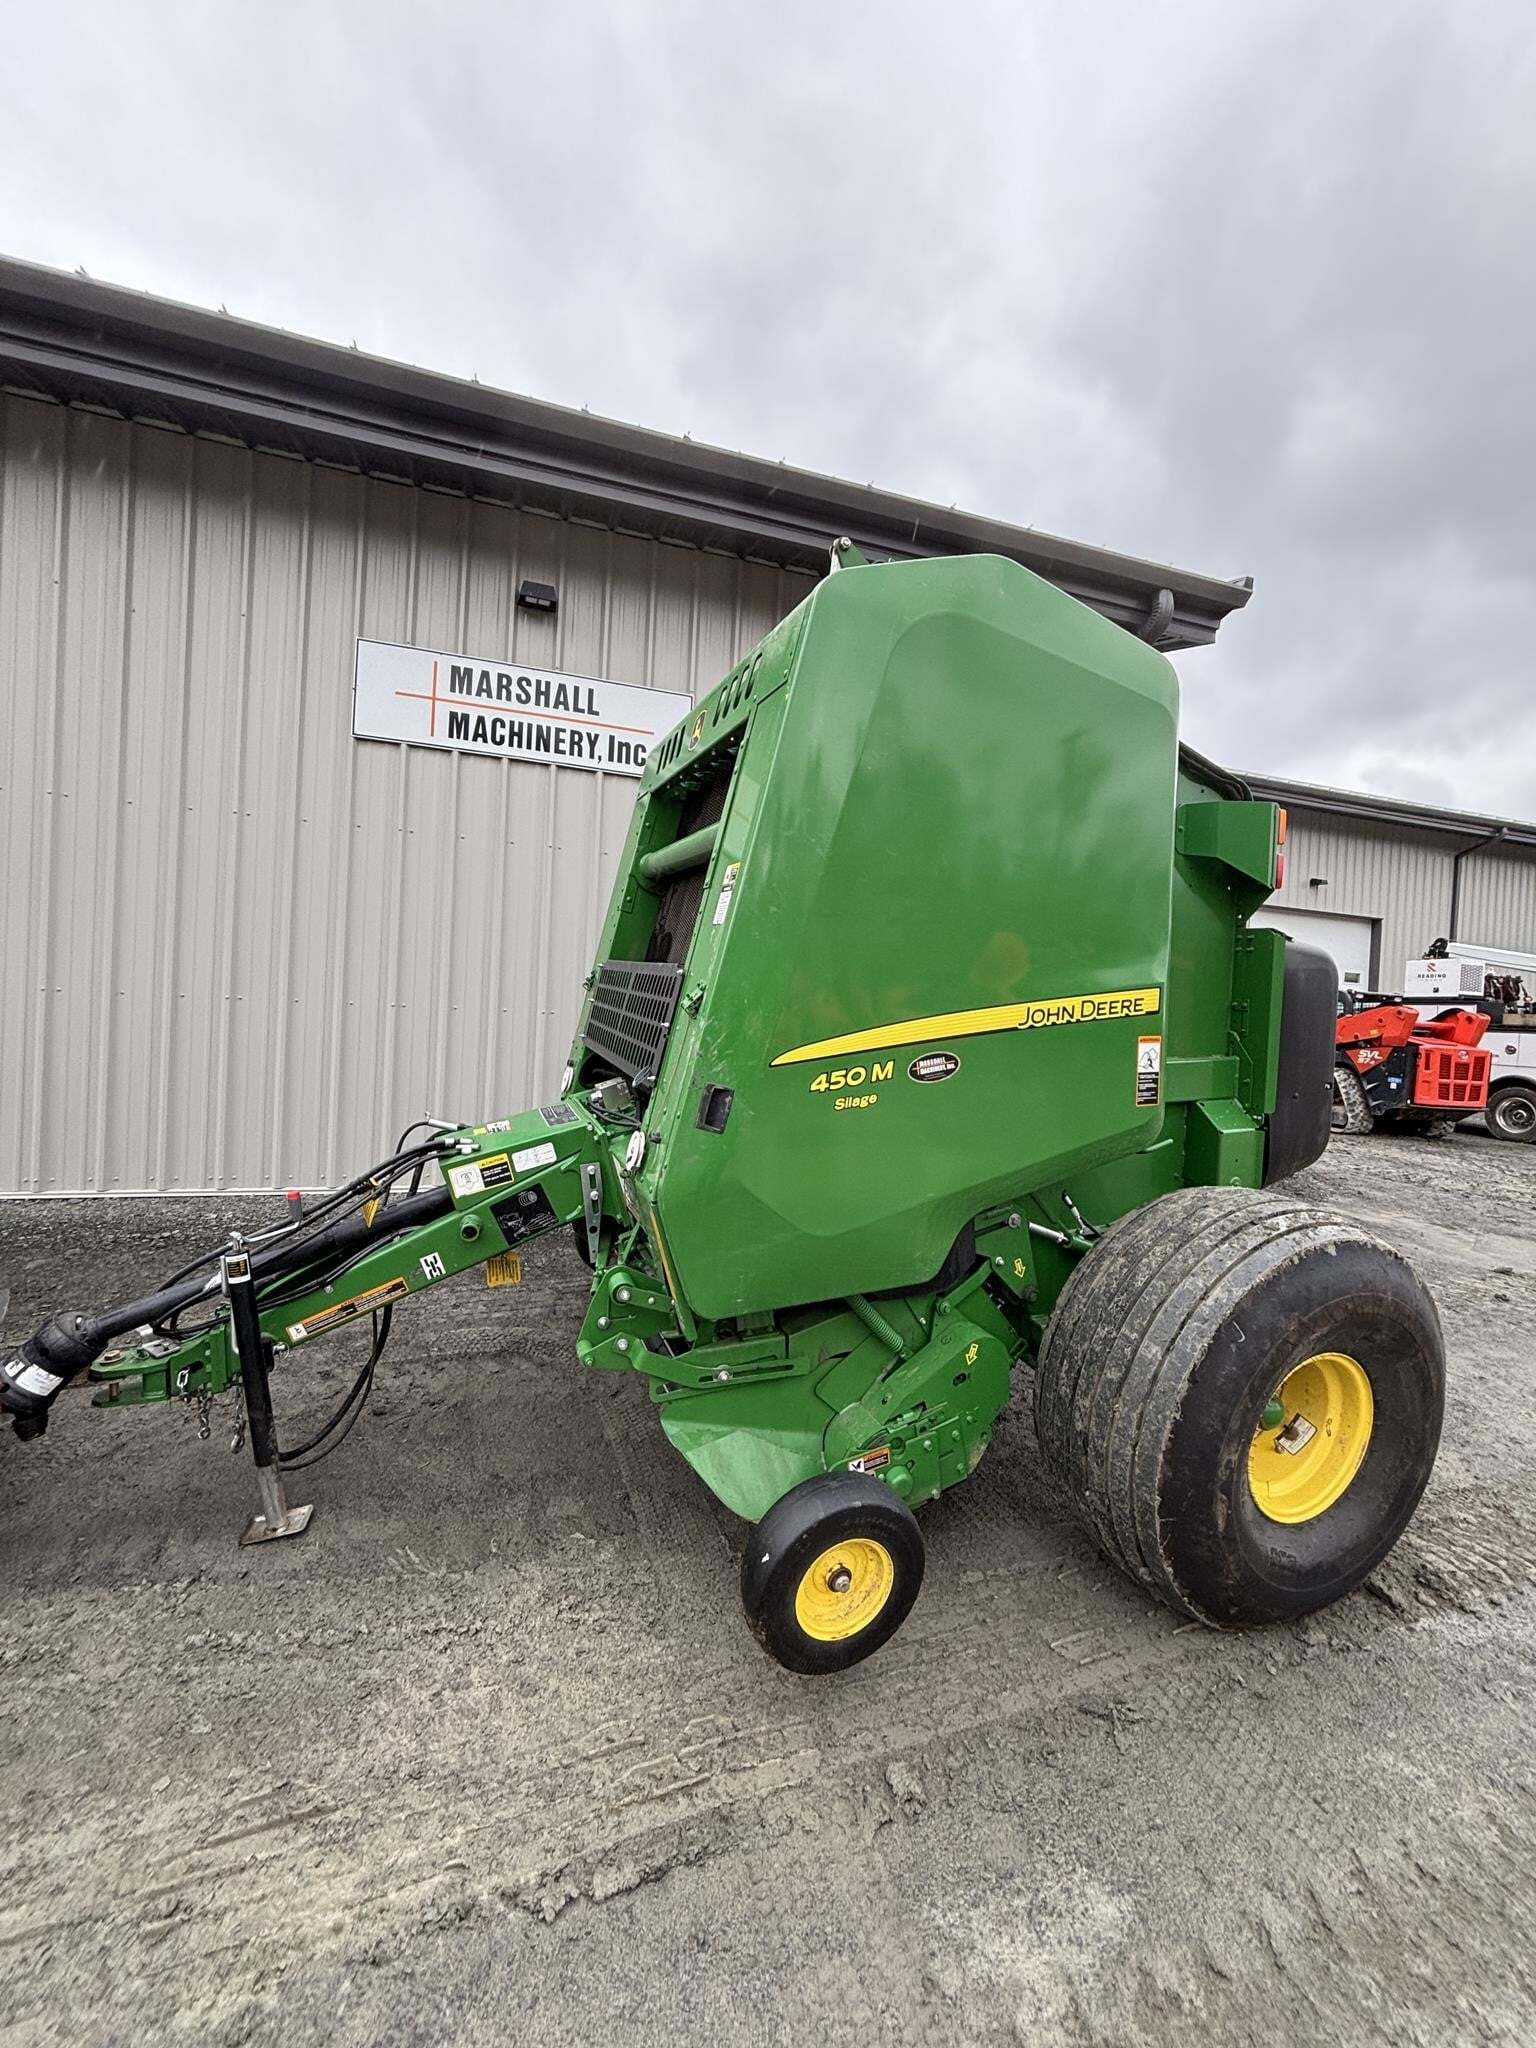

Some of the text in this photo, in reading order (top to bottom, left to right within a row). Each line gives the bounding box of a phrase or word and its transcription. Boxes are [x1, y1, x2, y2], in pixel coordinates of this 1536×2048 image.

[449, 664, 600, 716] MARSHALL
[447, 710, 602, 765] MACHINERY,
[1018, 997, 1145, 1027] JOHN DEERE
[810, 1059, 896, 1093] 450 M
[834, 1093, 879, 1111] Silage
